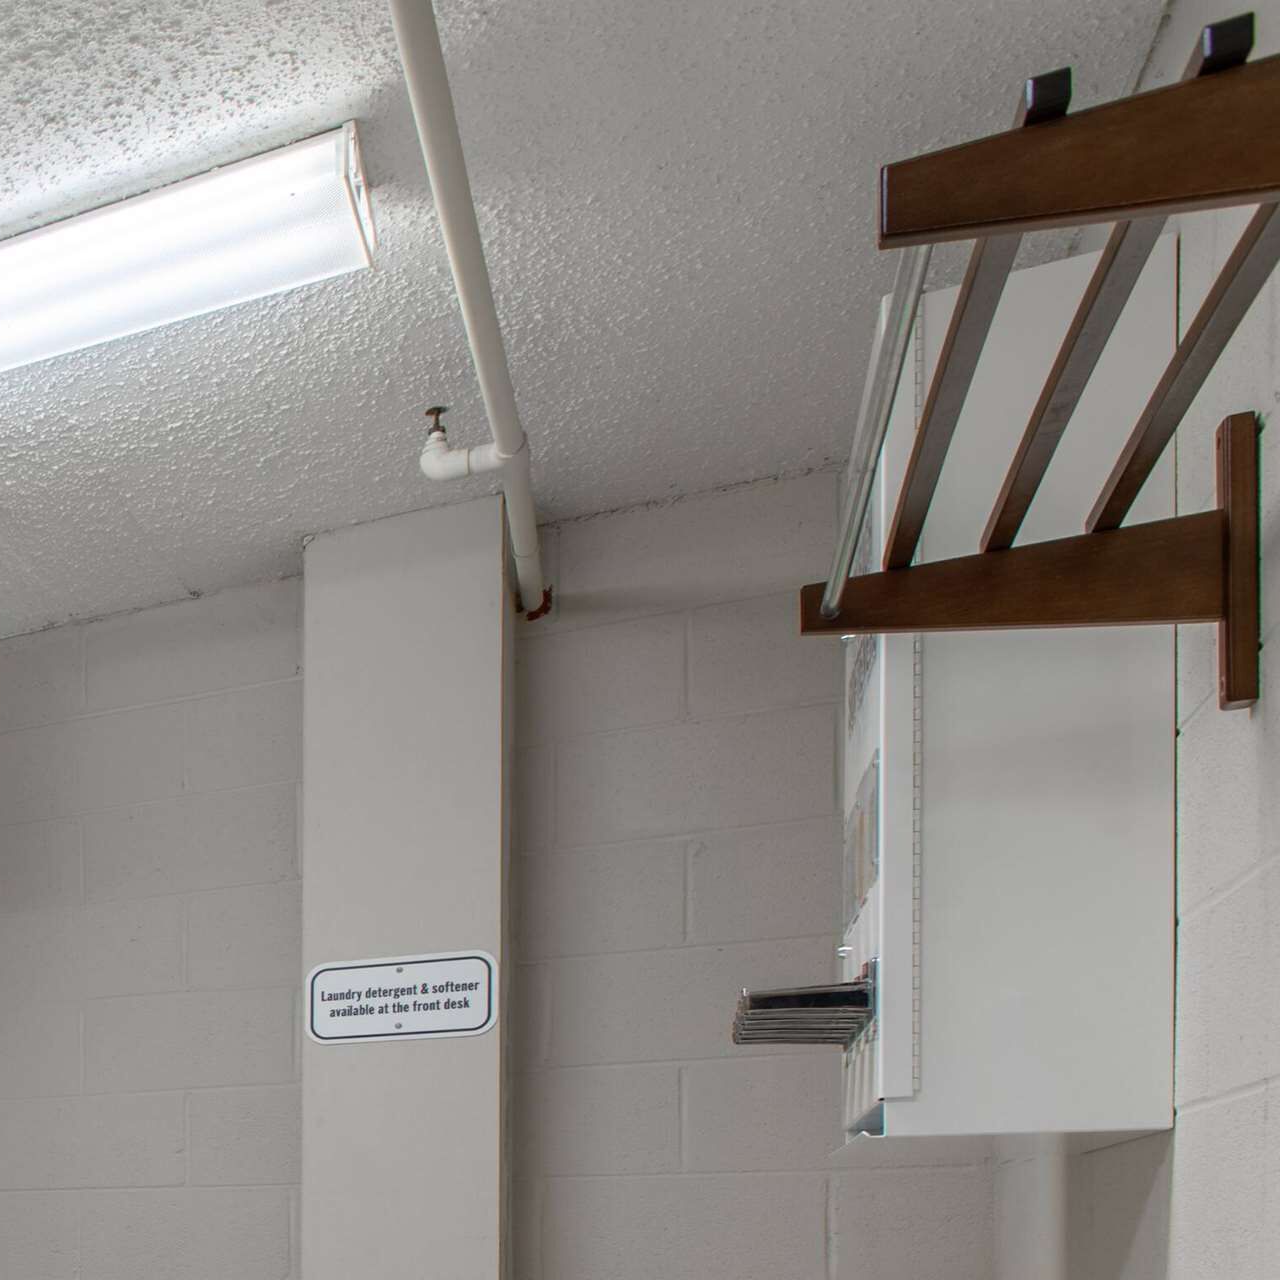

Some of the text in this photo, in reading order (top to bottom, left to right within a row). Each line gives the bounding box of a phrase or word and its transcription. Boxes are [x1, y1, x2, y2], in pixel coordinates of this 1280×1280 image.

[321, 981, 480, 1002] Laundry detergent & softener
[329, 997, 470, 1018] available at the front desk
